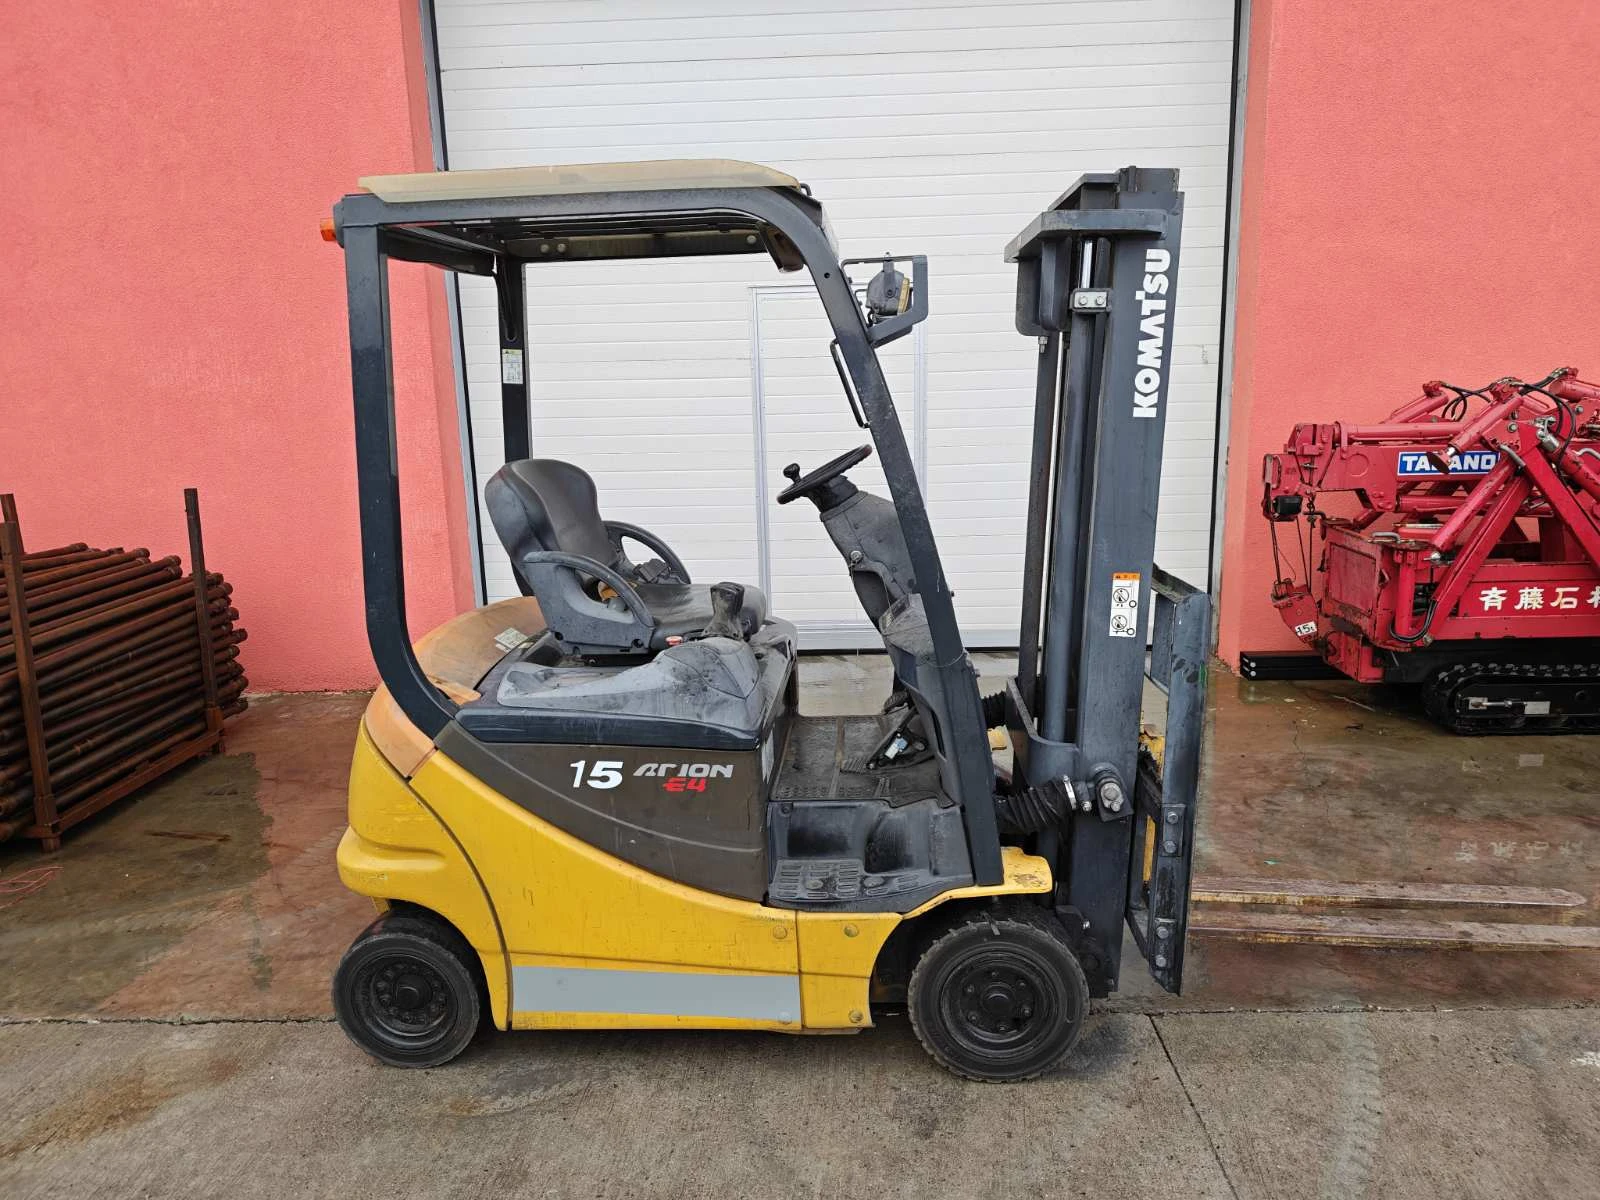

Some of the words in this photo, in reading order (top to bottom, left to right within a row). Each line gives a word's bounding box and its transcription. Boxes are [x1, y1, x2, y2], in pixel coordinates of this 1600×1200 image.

[1132, 248, 1171, 418] KOMATSU
[1402, 454, 1497, 472] TAANO
[569, 760, 624, 790] 15
[662, 777, 708, 793] E4
